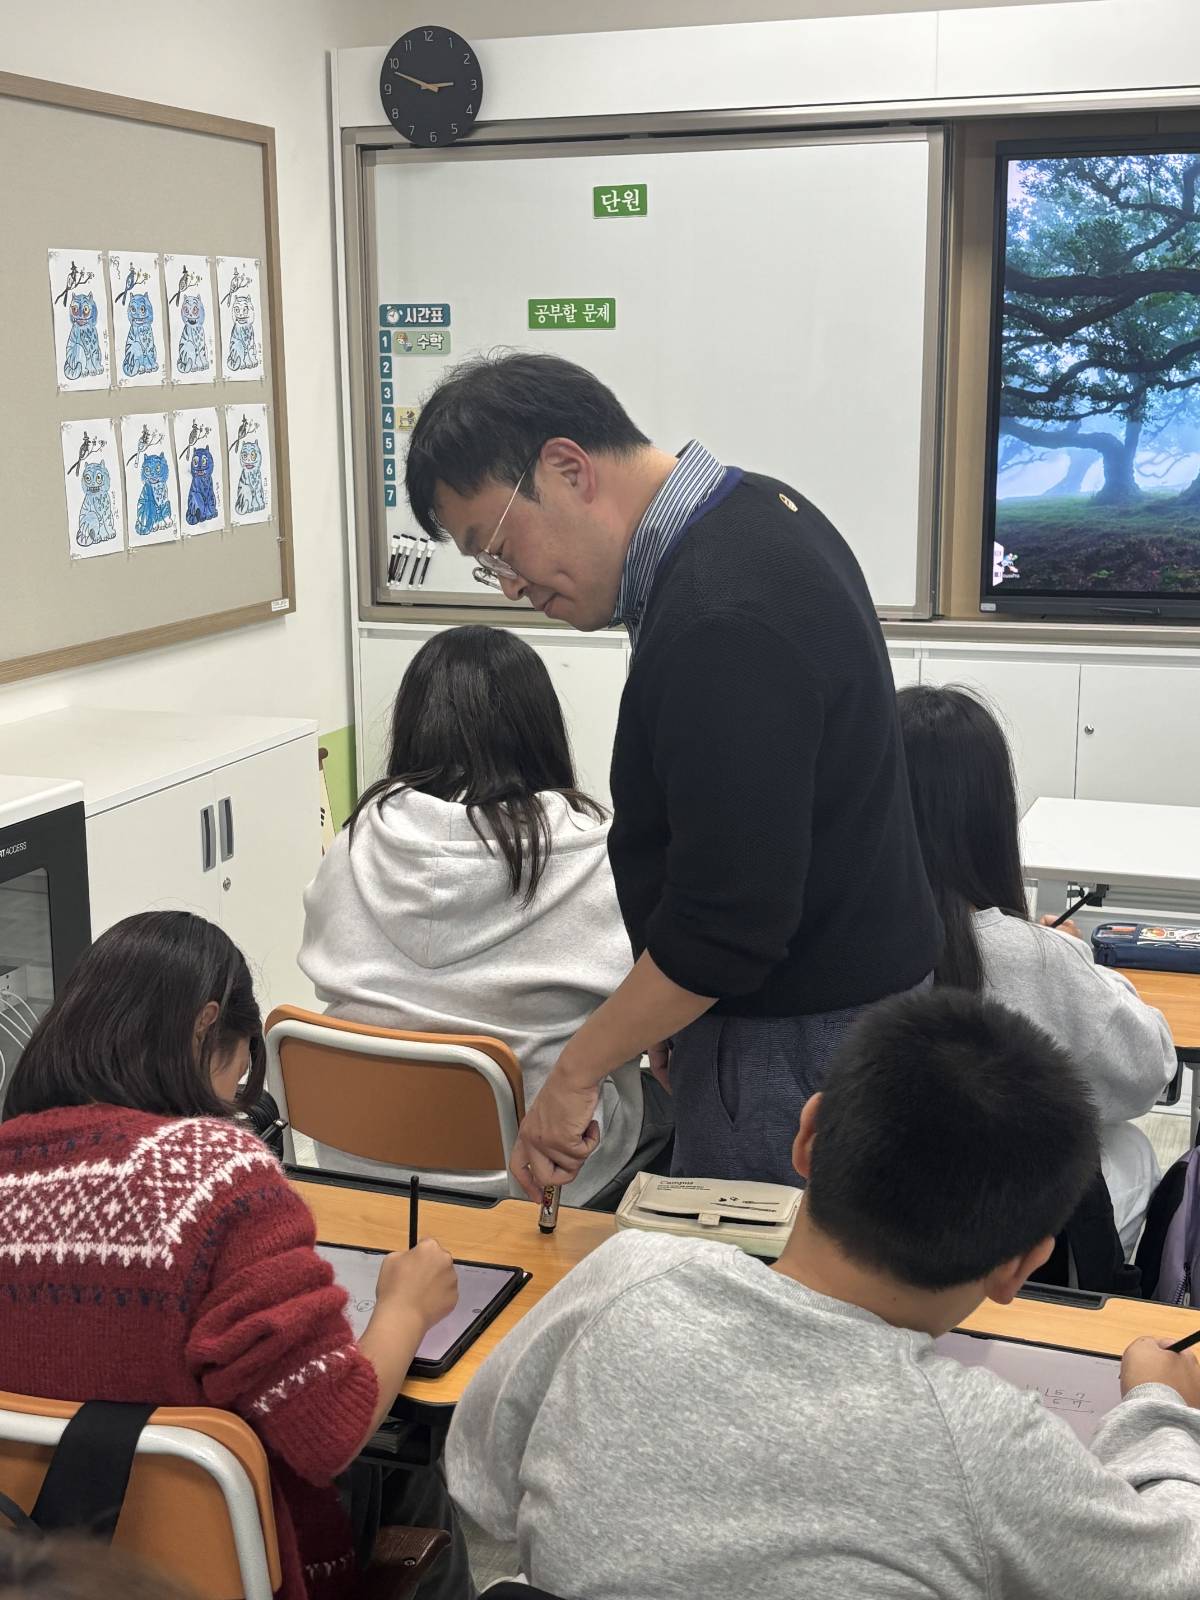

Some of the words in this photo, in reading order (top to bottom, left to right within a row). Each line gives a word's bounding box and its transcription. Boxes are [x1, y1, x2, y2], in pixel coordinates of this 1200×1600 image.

[423, 30, 434, 42] 12
[448, 36, 453, 48] 1
[404, 39, 412, 52] 11
[389, 57, 400, 69] 10
[463, 53, 470, 65] 2
[384, 83, 392, 95] 9
[471, 79, 478, 91] 3
[391, 107, 399, 119] 8
[465, 103, 473, 114] 4
[408, 125, 415, 136] 7
[450, 123, 458, 135] 5
[429, 131, 437, 143] 6
[600, 188, 641, 213] 단원
[404, 307, 444, 324] 시간표
[534, 303, 578, 324] 공부할
[582, 302, 610, 323] 문제
[382, 335, 388, 348] 1
[417, 332, 445, 351] 수학
[382, 361, 390, 373] 2
[383, 387, 391, 399] 3
[384, 412, 392, 424] 4
[385, 437, 393, 449] 5
[385, 463, 393, 475] 6
[386, 489, 394, 501] 7
